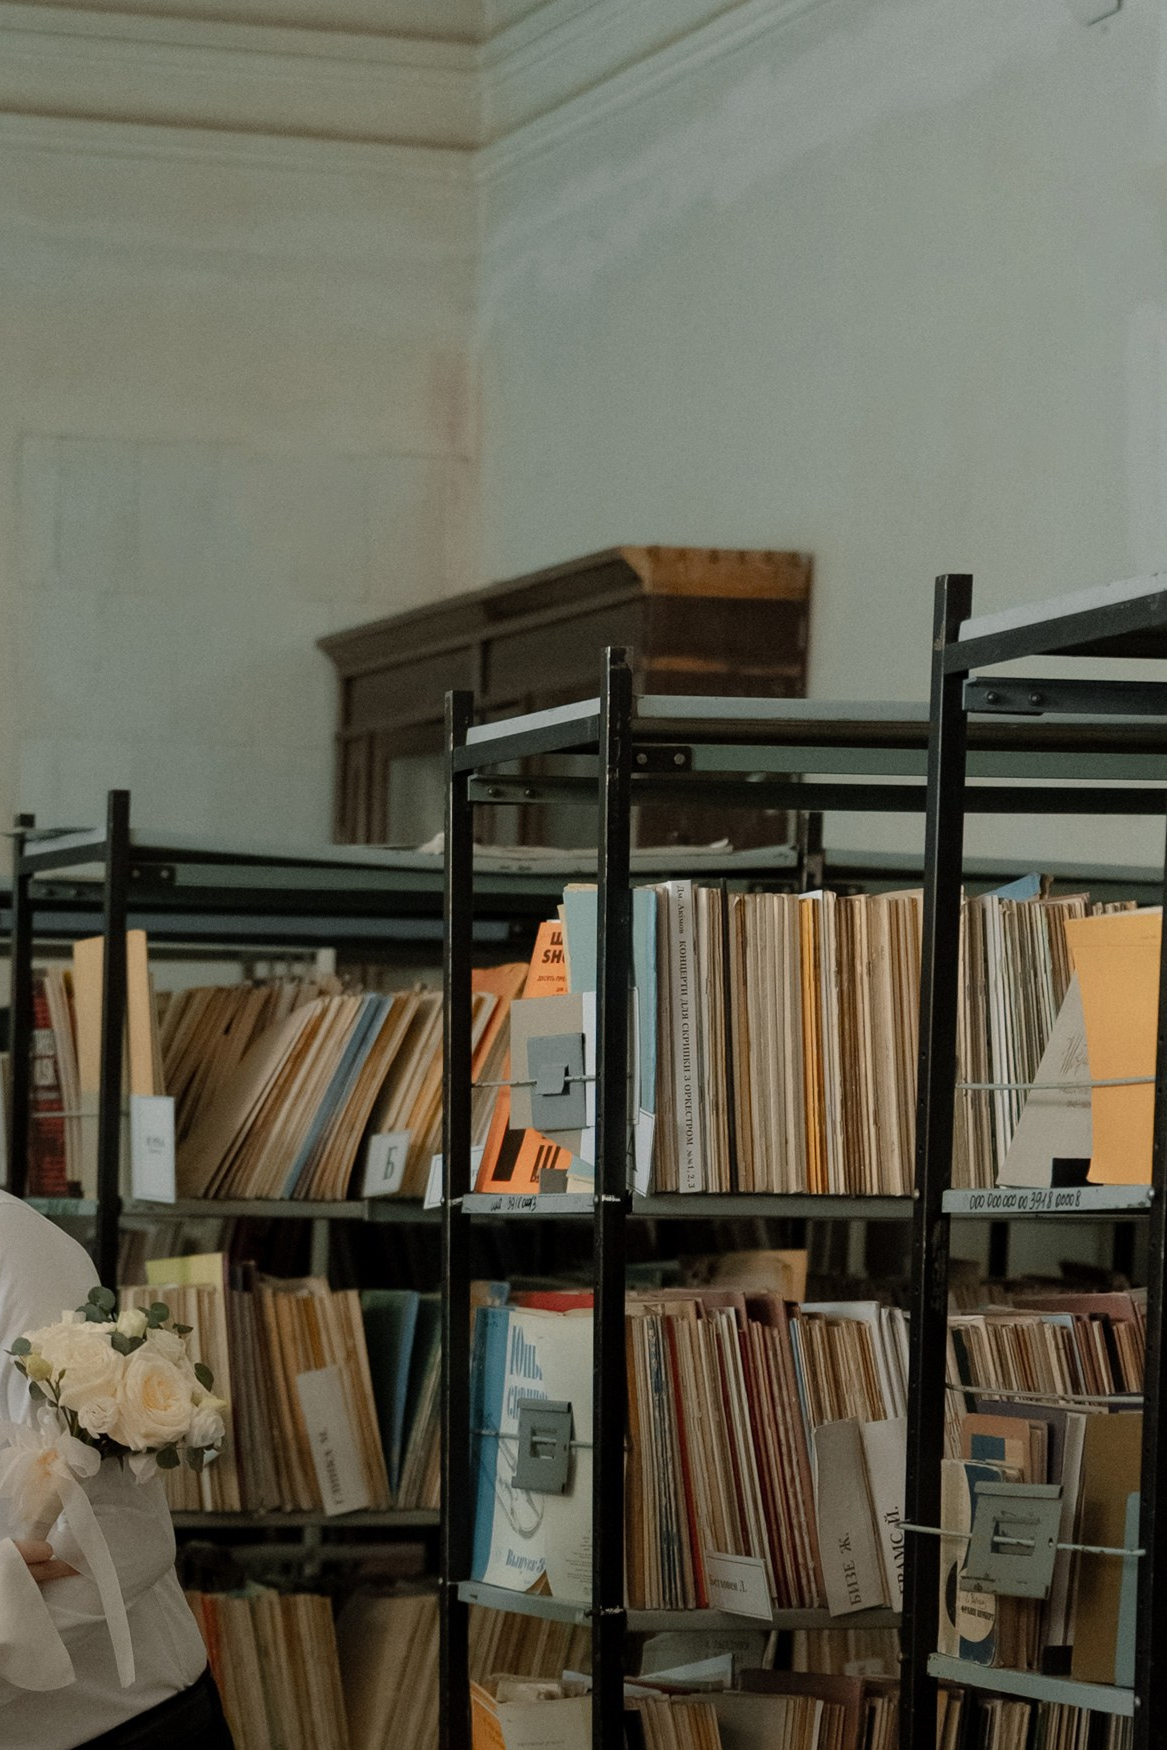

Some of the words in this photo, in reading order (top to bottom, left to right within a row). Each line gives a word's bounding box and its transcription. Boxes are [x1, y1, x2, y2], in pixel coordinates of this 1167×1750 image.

[550, 932, 564, 945] Ш
[541, 949, 565, 964] SH
[679, 940, 688, 996] КОНЦЕРТИ
[680, 999, 689, 1020] ДЛЯ
[682, 1022, 691, 1072] СКРИПКИ
[684, 1084, 694, 1145] ОРКЕСТРОМ
[838, 1532, 852, 1554] Ж.
[842, 1560, 862, 1605] БИЗЕ
